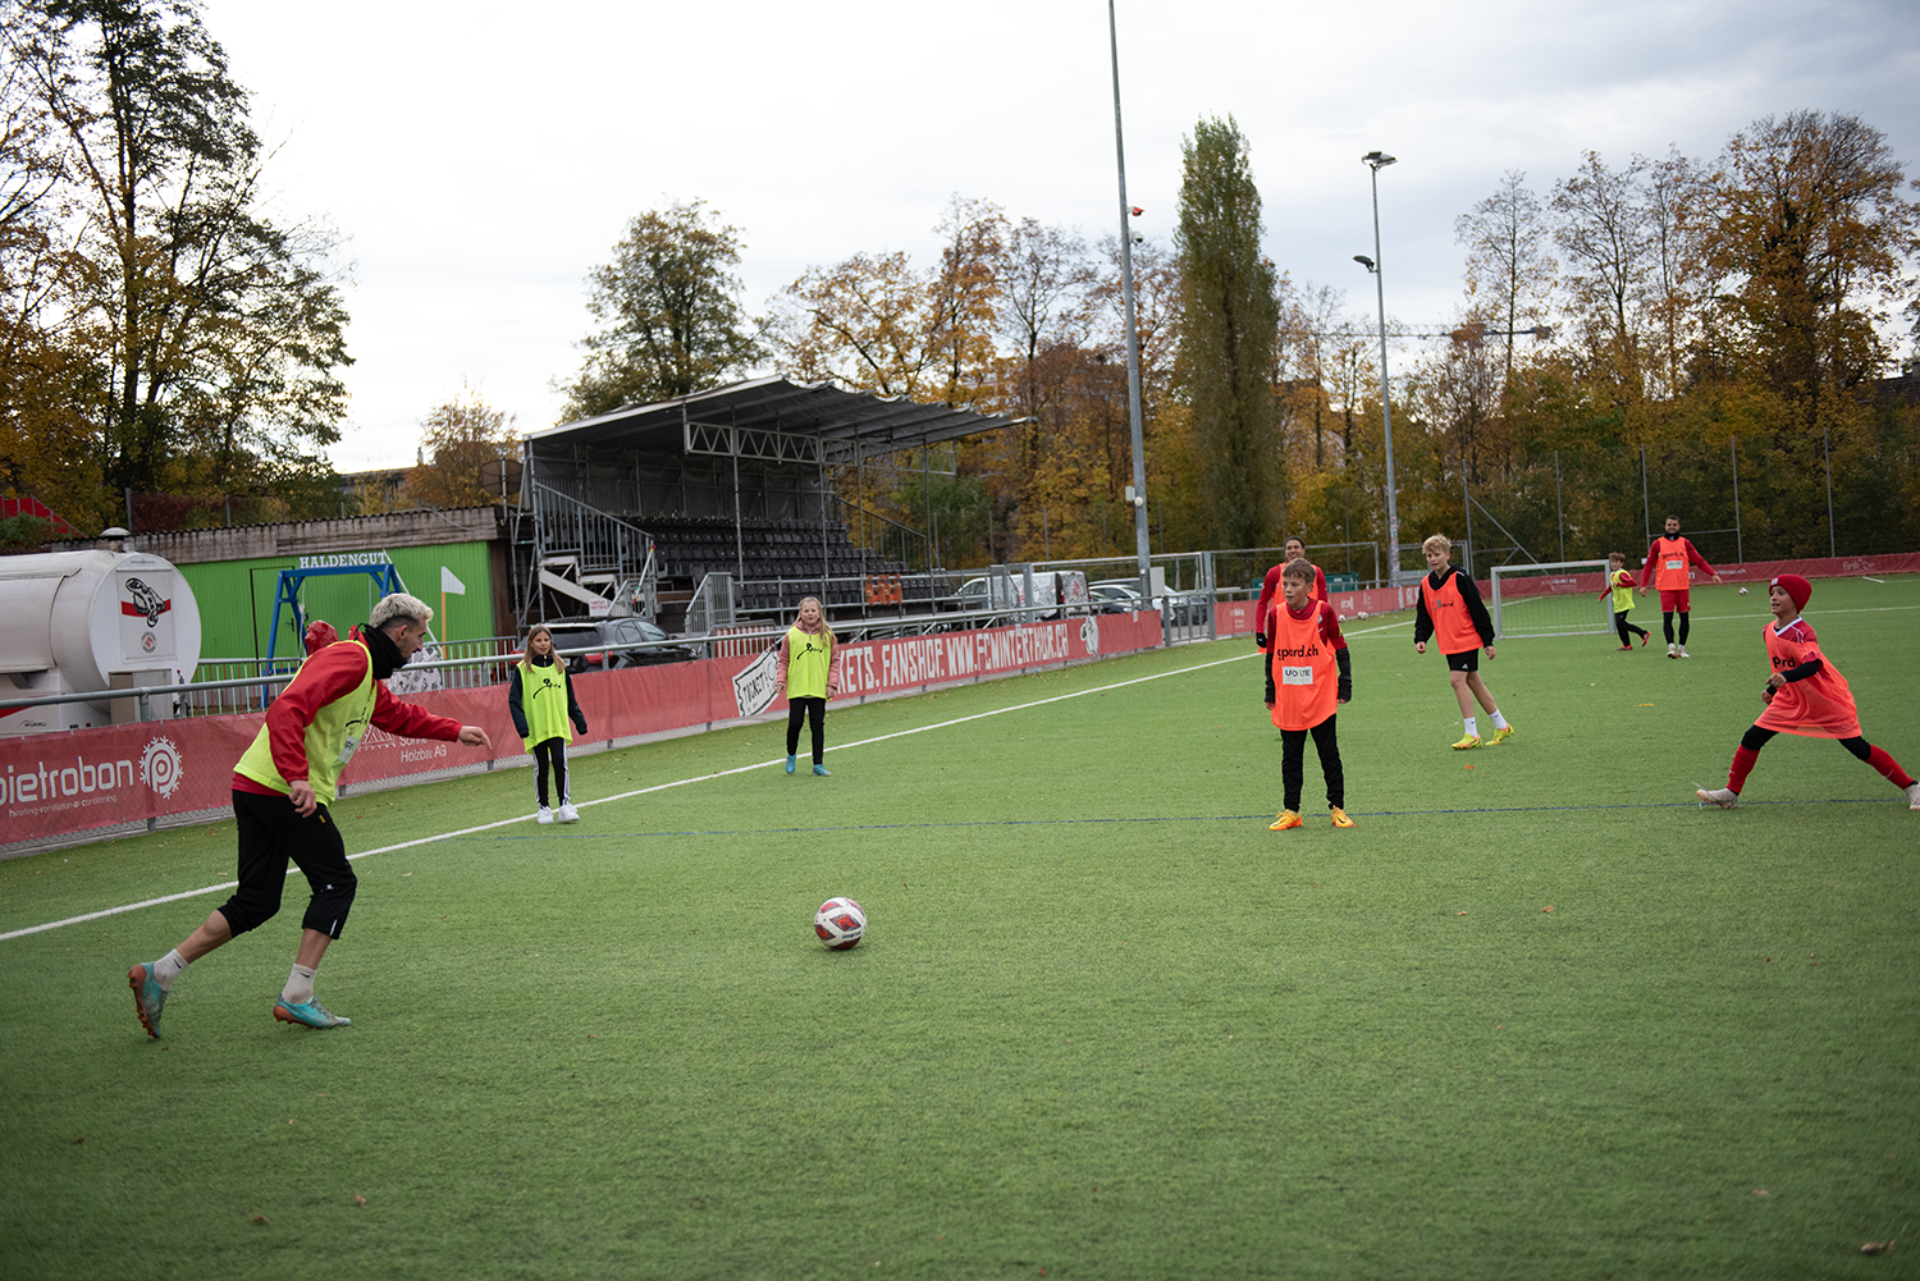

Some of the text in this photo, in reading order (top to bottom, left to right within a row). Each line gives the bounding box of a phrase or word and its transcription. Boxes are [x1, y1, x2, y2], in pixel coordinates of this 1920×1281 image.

[299, 552, 386, 569] HALDENGUT
[837, 646, 880, 695] KETS.
[881, 637, 945, 687] FANSHOP.
[434, 744, 447, 758] AG
